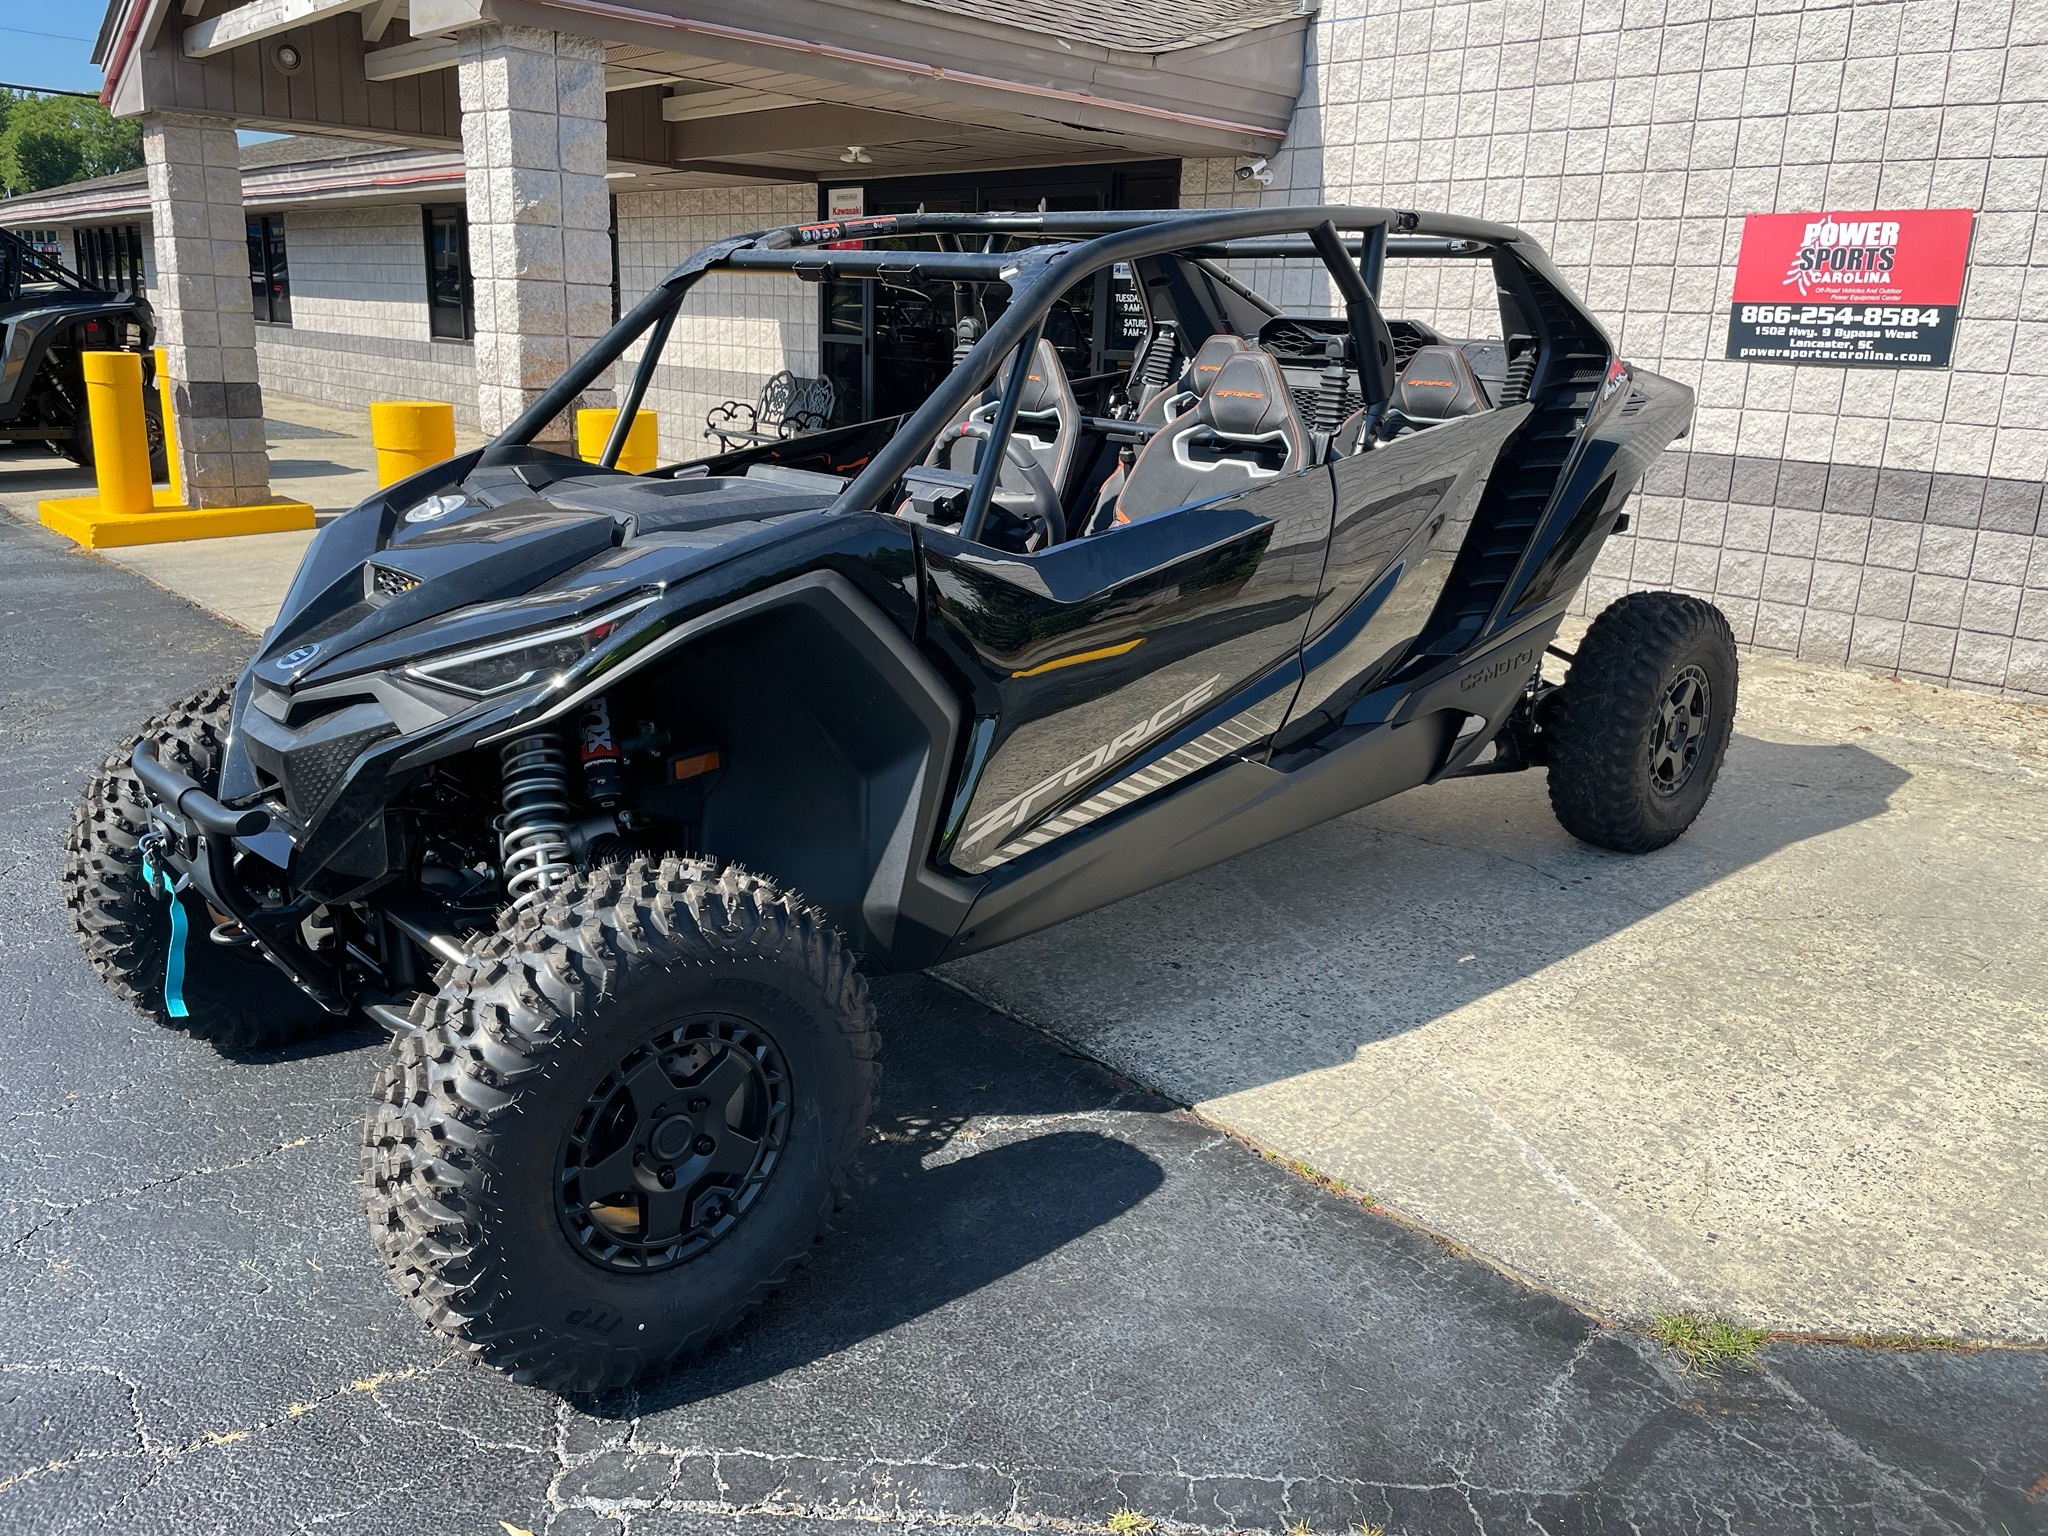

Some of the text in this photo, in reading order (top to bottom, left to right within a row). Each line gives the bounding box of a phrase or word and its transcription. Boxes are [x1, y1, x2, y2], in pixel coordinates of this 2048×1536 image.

[832, 206, 862, 216] Kawasaki
[1801, 221, 1900, 247] POWER
[1800, 246, 1896, 271] SPORTS
[1811, 271, 1891, 284] CAROLINA
[1123, 303, 1129, 312] 9
[1740, 305, 1940, 327] 866-254-8584
[1123, 328, 1128, 336] 9
[1755, 326, 1918, 340] 1502 Hwy. 9 Bypass West
[1789, 338, 1874, 350] Lancaster, SC
[1739, 347, 1932, 363] powersportscarolina.com
[1460, 648, 1533, 692] CFMOTO
[580, 696, 612, 754] FOX
[961, 673, 1221, 850] ZFORCE
[565, 1307, 624, 1335] ITP
